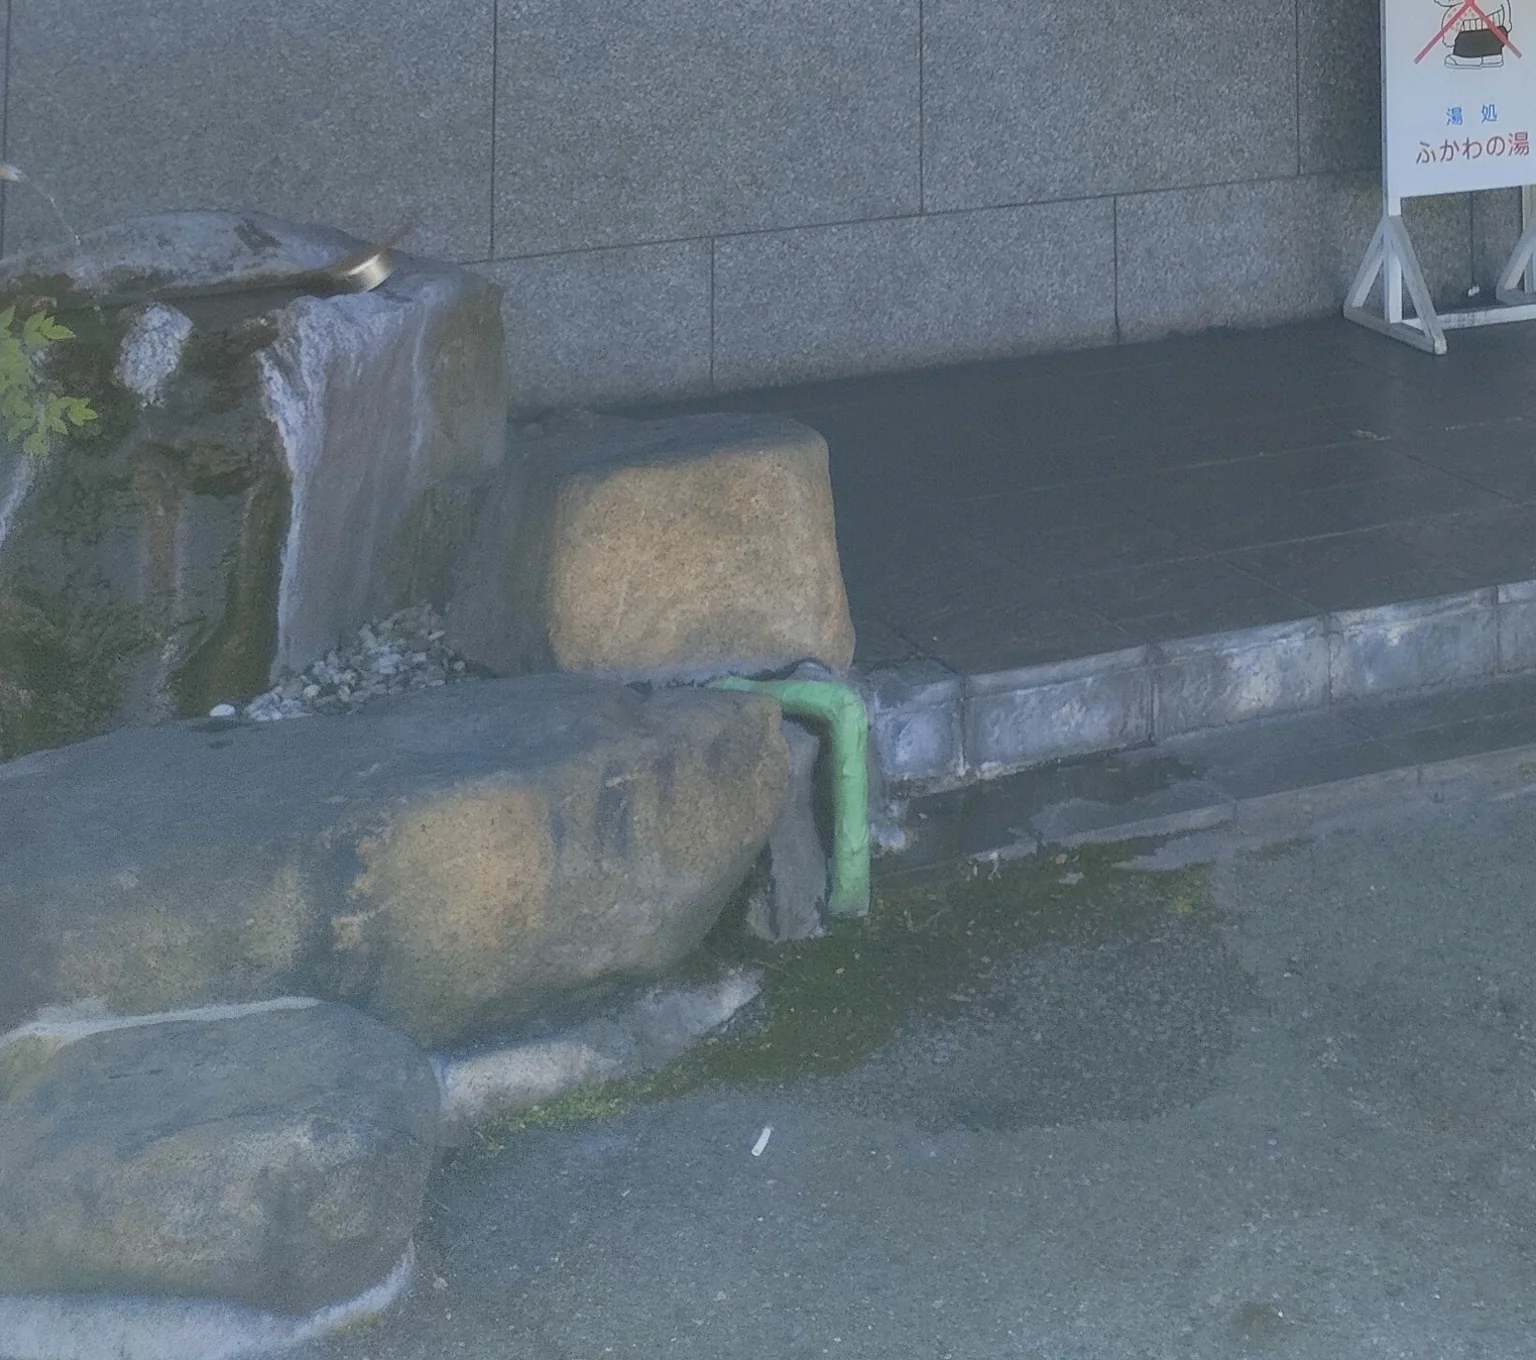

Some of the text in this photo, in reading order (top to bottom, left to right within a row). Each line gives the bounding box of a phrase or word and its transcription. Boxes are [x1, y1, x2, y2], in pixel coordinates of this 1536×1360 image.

[1415, 131, 1530, 165] ふかわの湯
